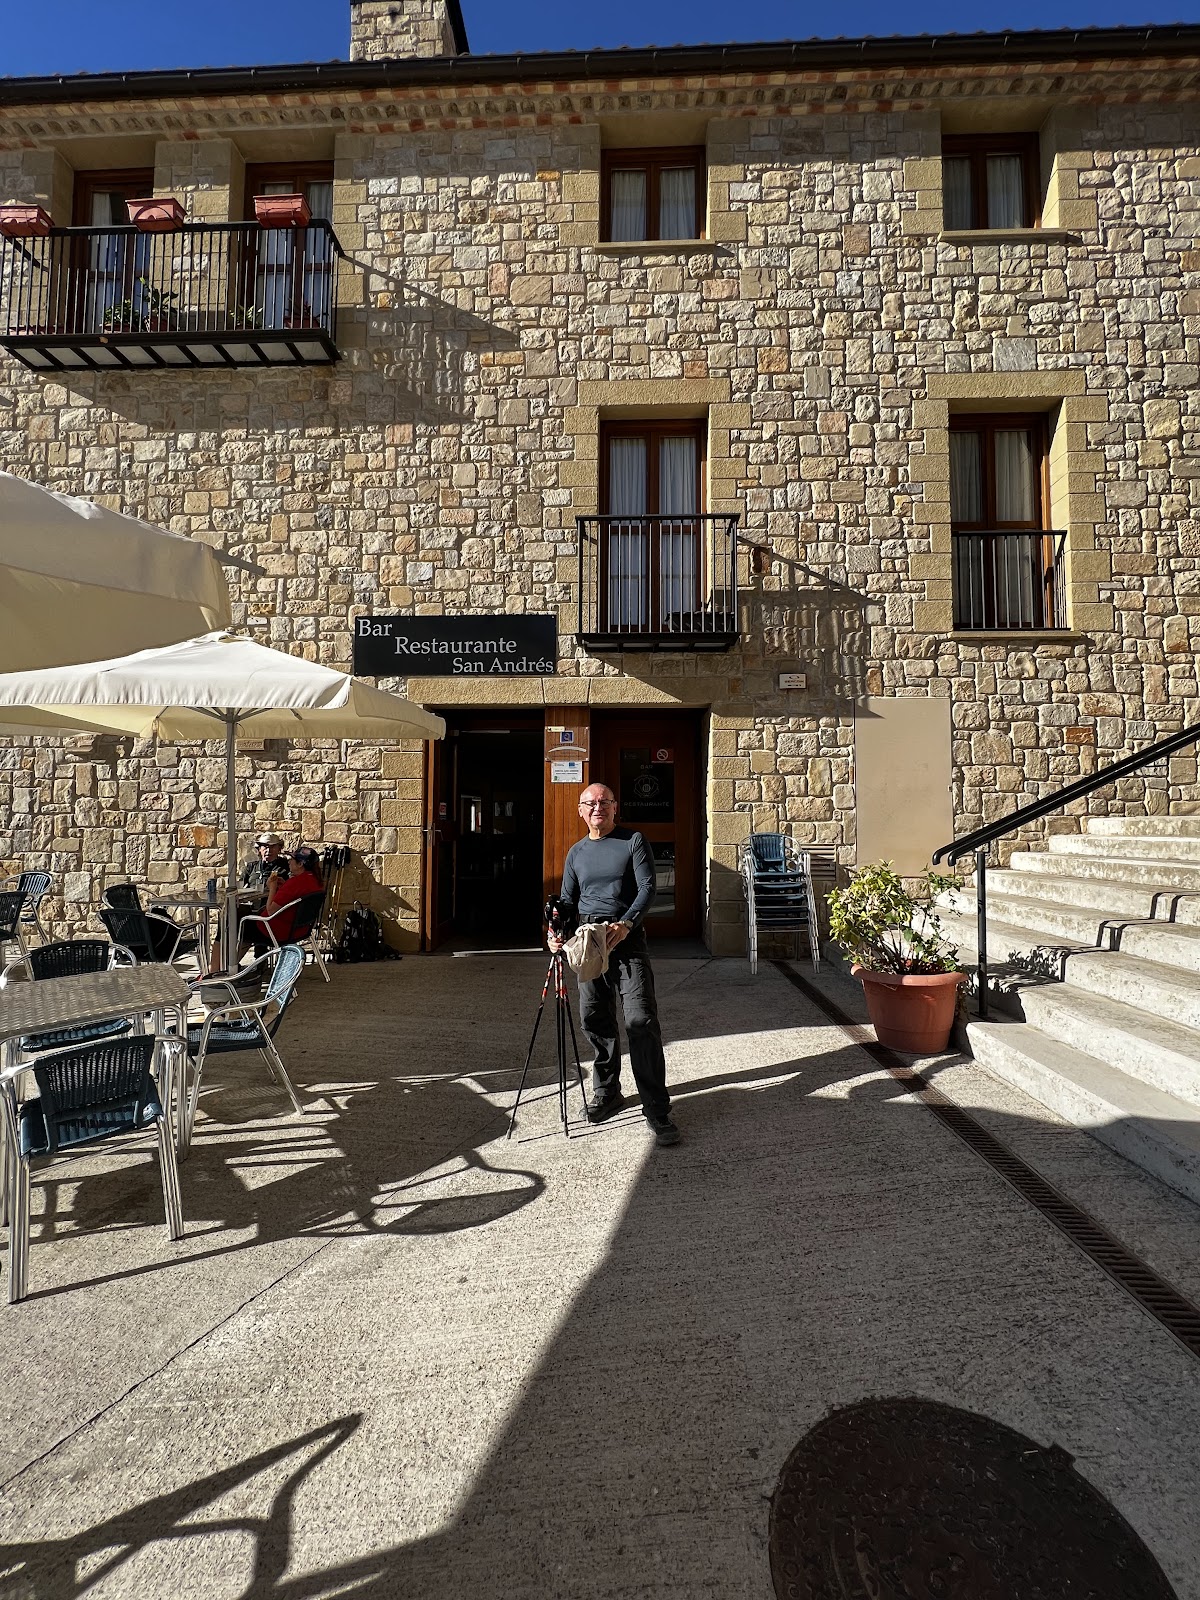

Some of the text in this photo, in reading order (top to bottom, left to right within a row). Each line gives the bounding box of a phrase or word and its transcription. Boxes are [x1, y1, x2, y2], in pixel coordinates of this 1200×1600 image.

[357, 618, 393, 637] Bar
[394, 636, 517, 655] Restaurante
[452, 656, 554, 674] San Andrés
